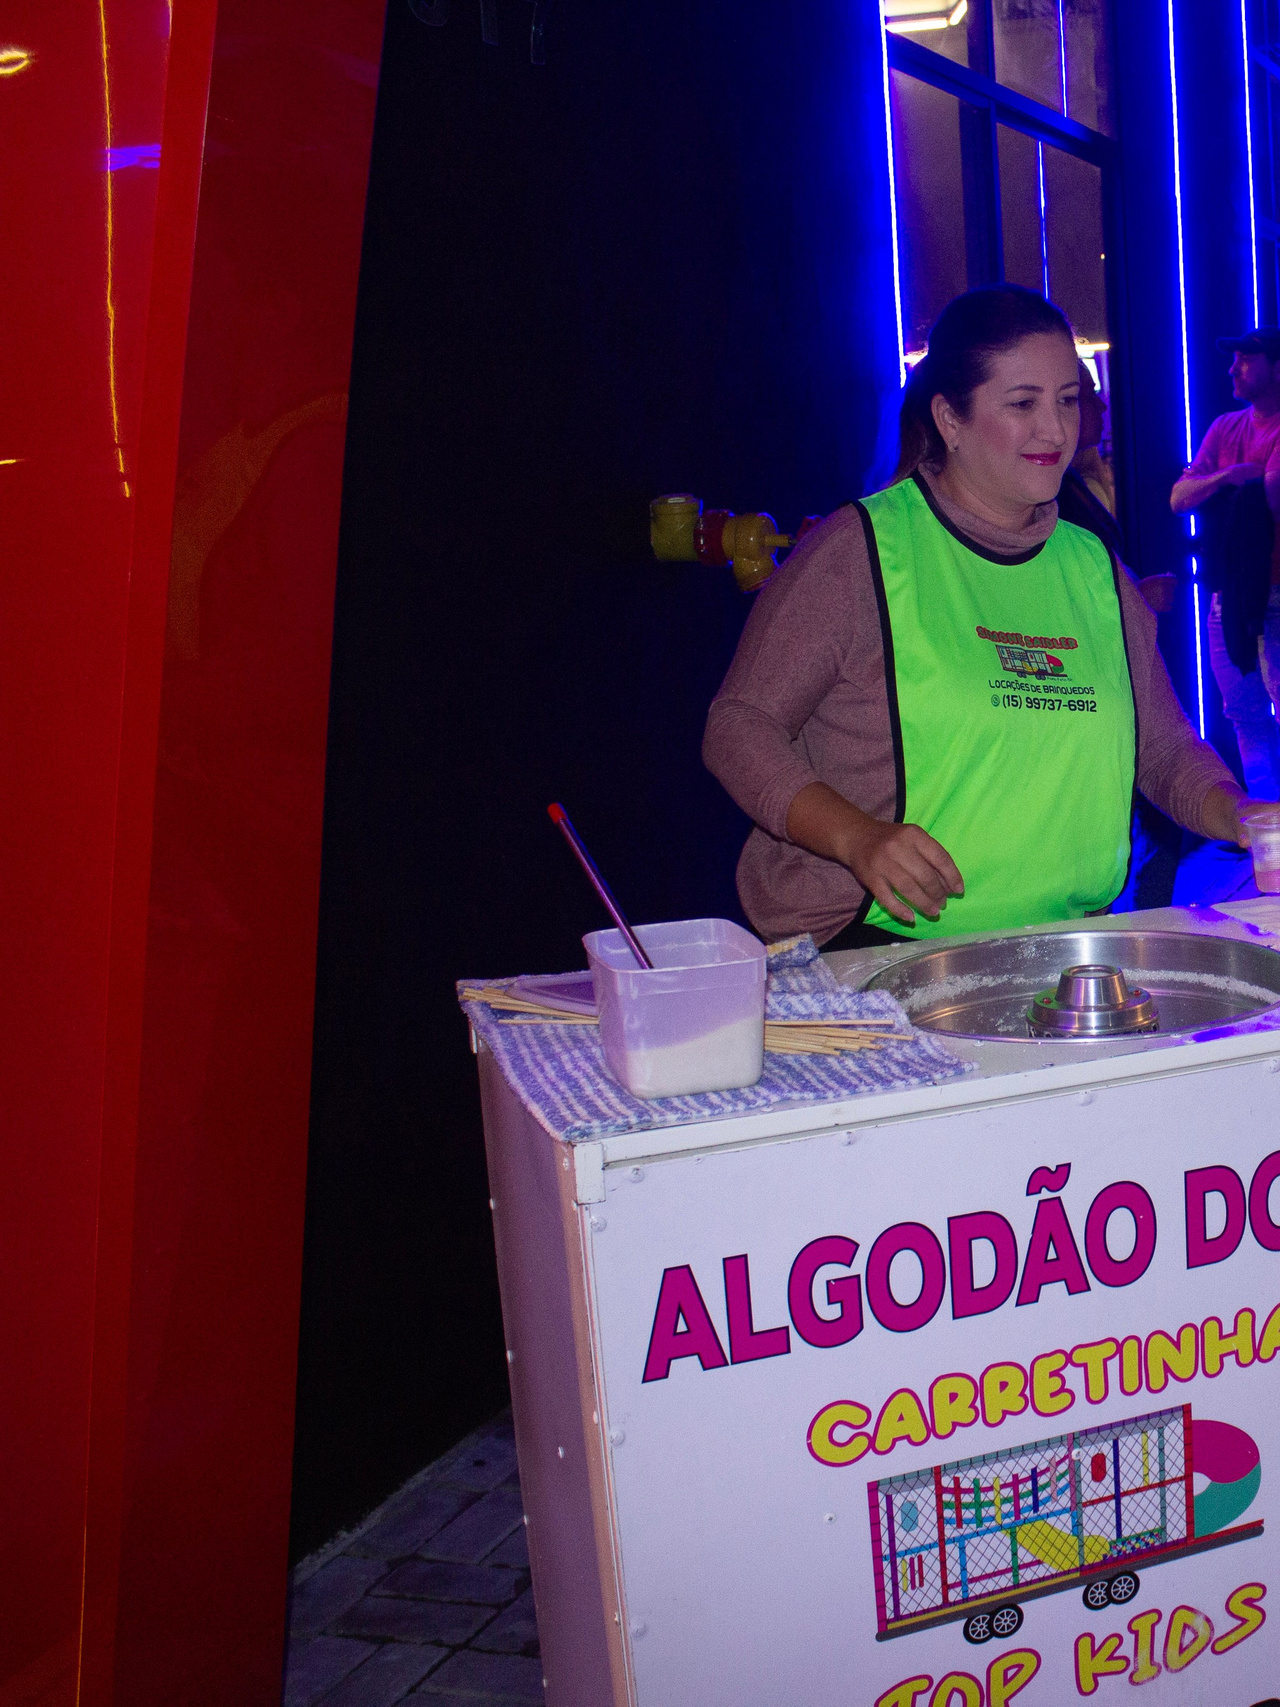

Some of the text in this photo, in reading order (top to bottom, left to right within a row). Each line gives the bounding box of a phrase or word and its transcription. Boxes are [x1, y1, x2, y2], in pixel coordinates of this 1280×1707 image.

[988, 680, 1095, 695] LOCAÇÕES DE BRINQUEDOS
[1002, 694, 1097, 712] (15) 99737-6912
[642, 1163, 1157, 1383] ALGODÃO
[1074, 1582, 1267, 1696] KIDS
